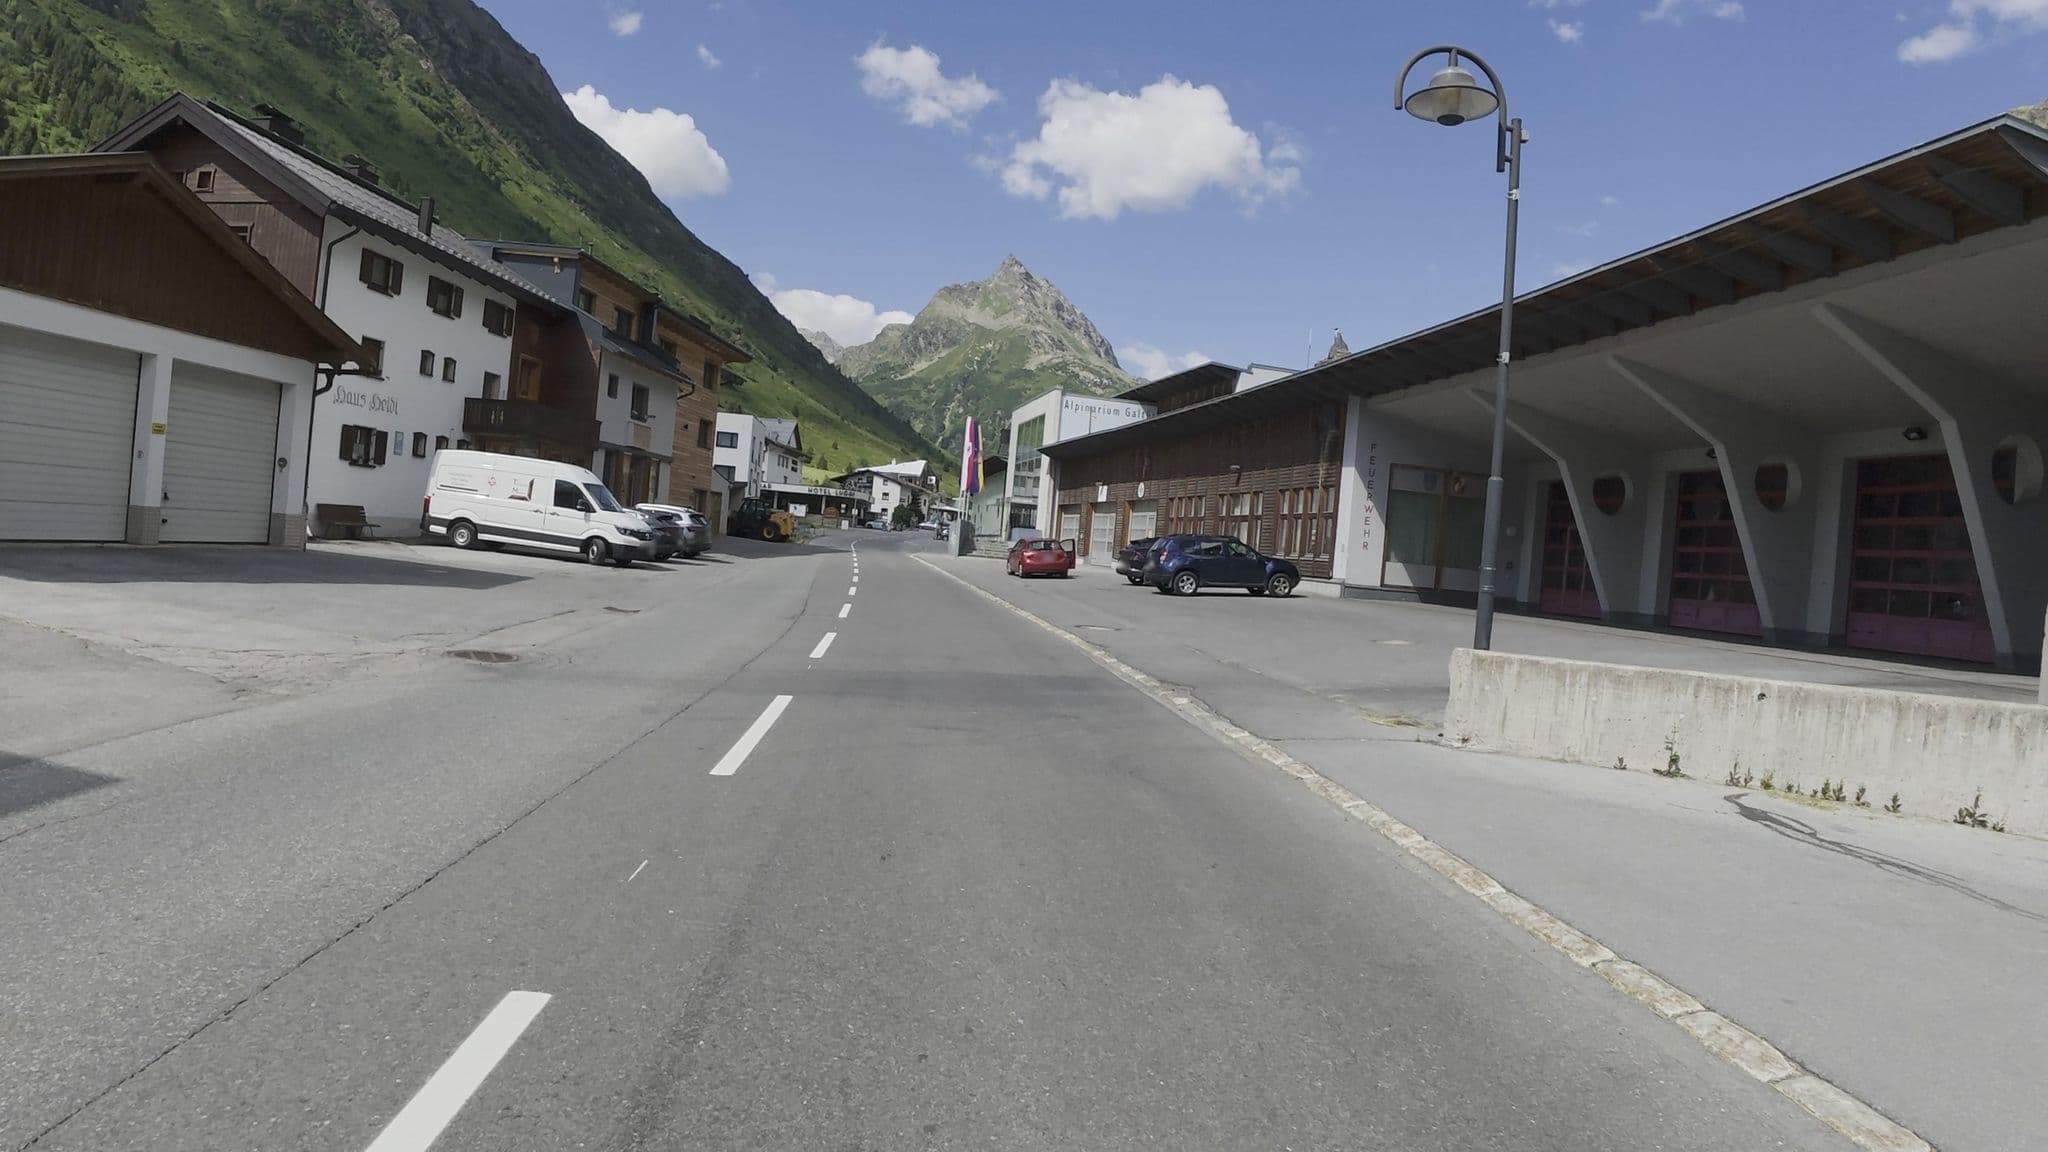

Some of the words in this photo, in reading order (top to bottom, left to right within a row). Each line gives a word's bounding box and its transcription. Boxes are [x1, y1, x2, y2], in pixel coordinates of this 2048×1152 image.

[333, 385, 366, 408] Haus
[369, 393, 398, 415] Heidi
[1063, 399, 1120, 417] Alpinarium
[807, 487, 832, 496] HOTEL
[1362, 443, 1377, 551] FEUERWEHR
